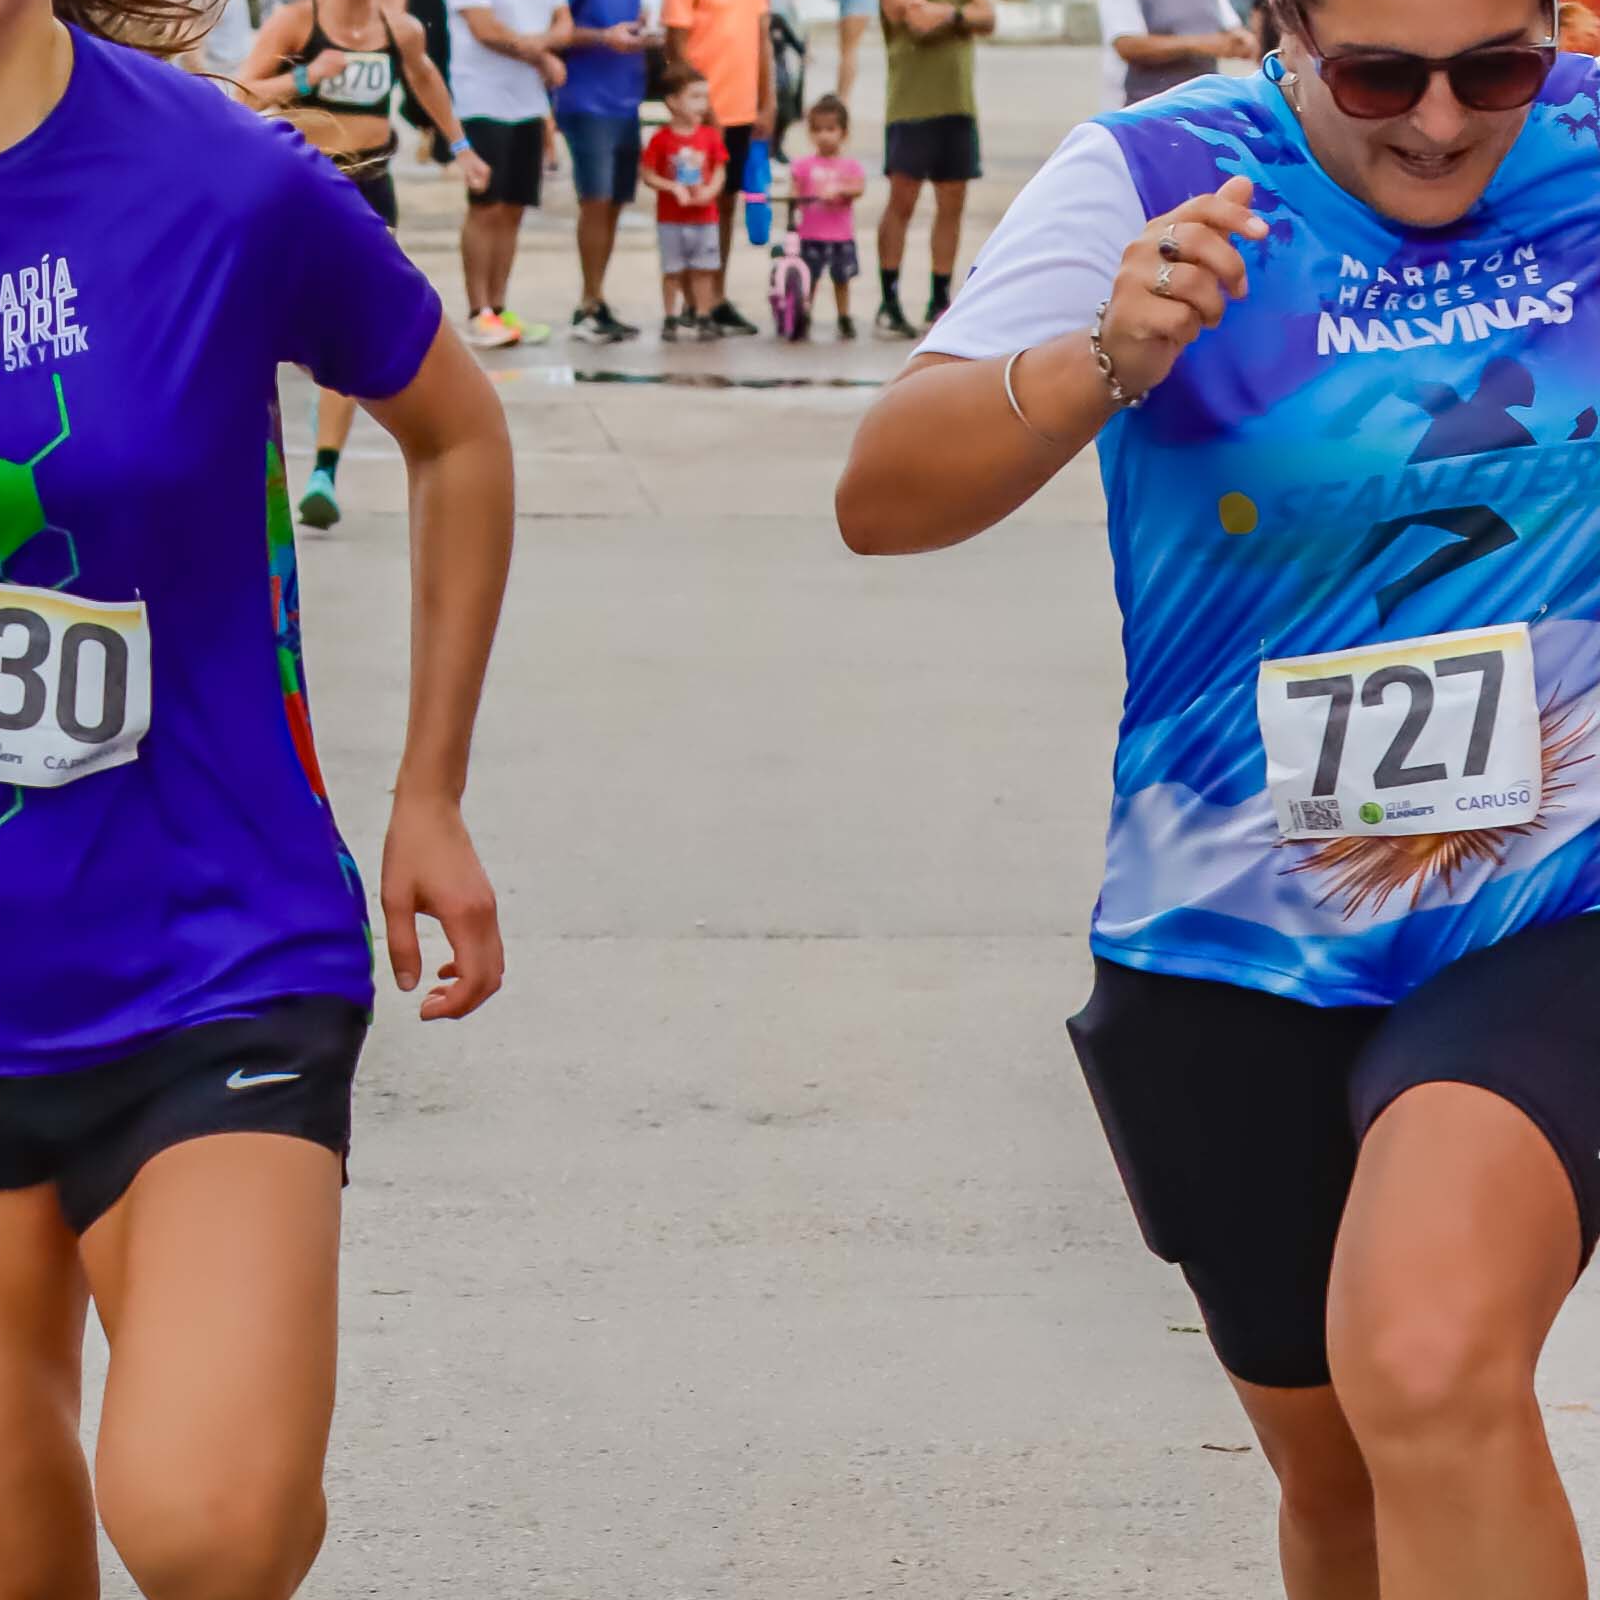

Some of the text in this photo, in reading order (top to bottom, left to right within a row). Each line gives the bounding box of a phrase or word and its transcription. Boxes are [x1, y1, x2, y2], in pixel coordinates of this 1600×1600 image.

[1339, 243, 1536, 286] MARATÓN
[1339, 264, 1543, 312] HÉROES DE
[1317, 281, 1578, 356] MALVINAS
[1450, 443, 1600, 503] ETER
[1286, 650, 1505, 797] 727
[1456, 789, 1532, 811] CARUSO
